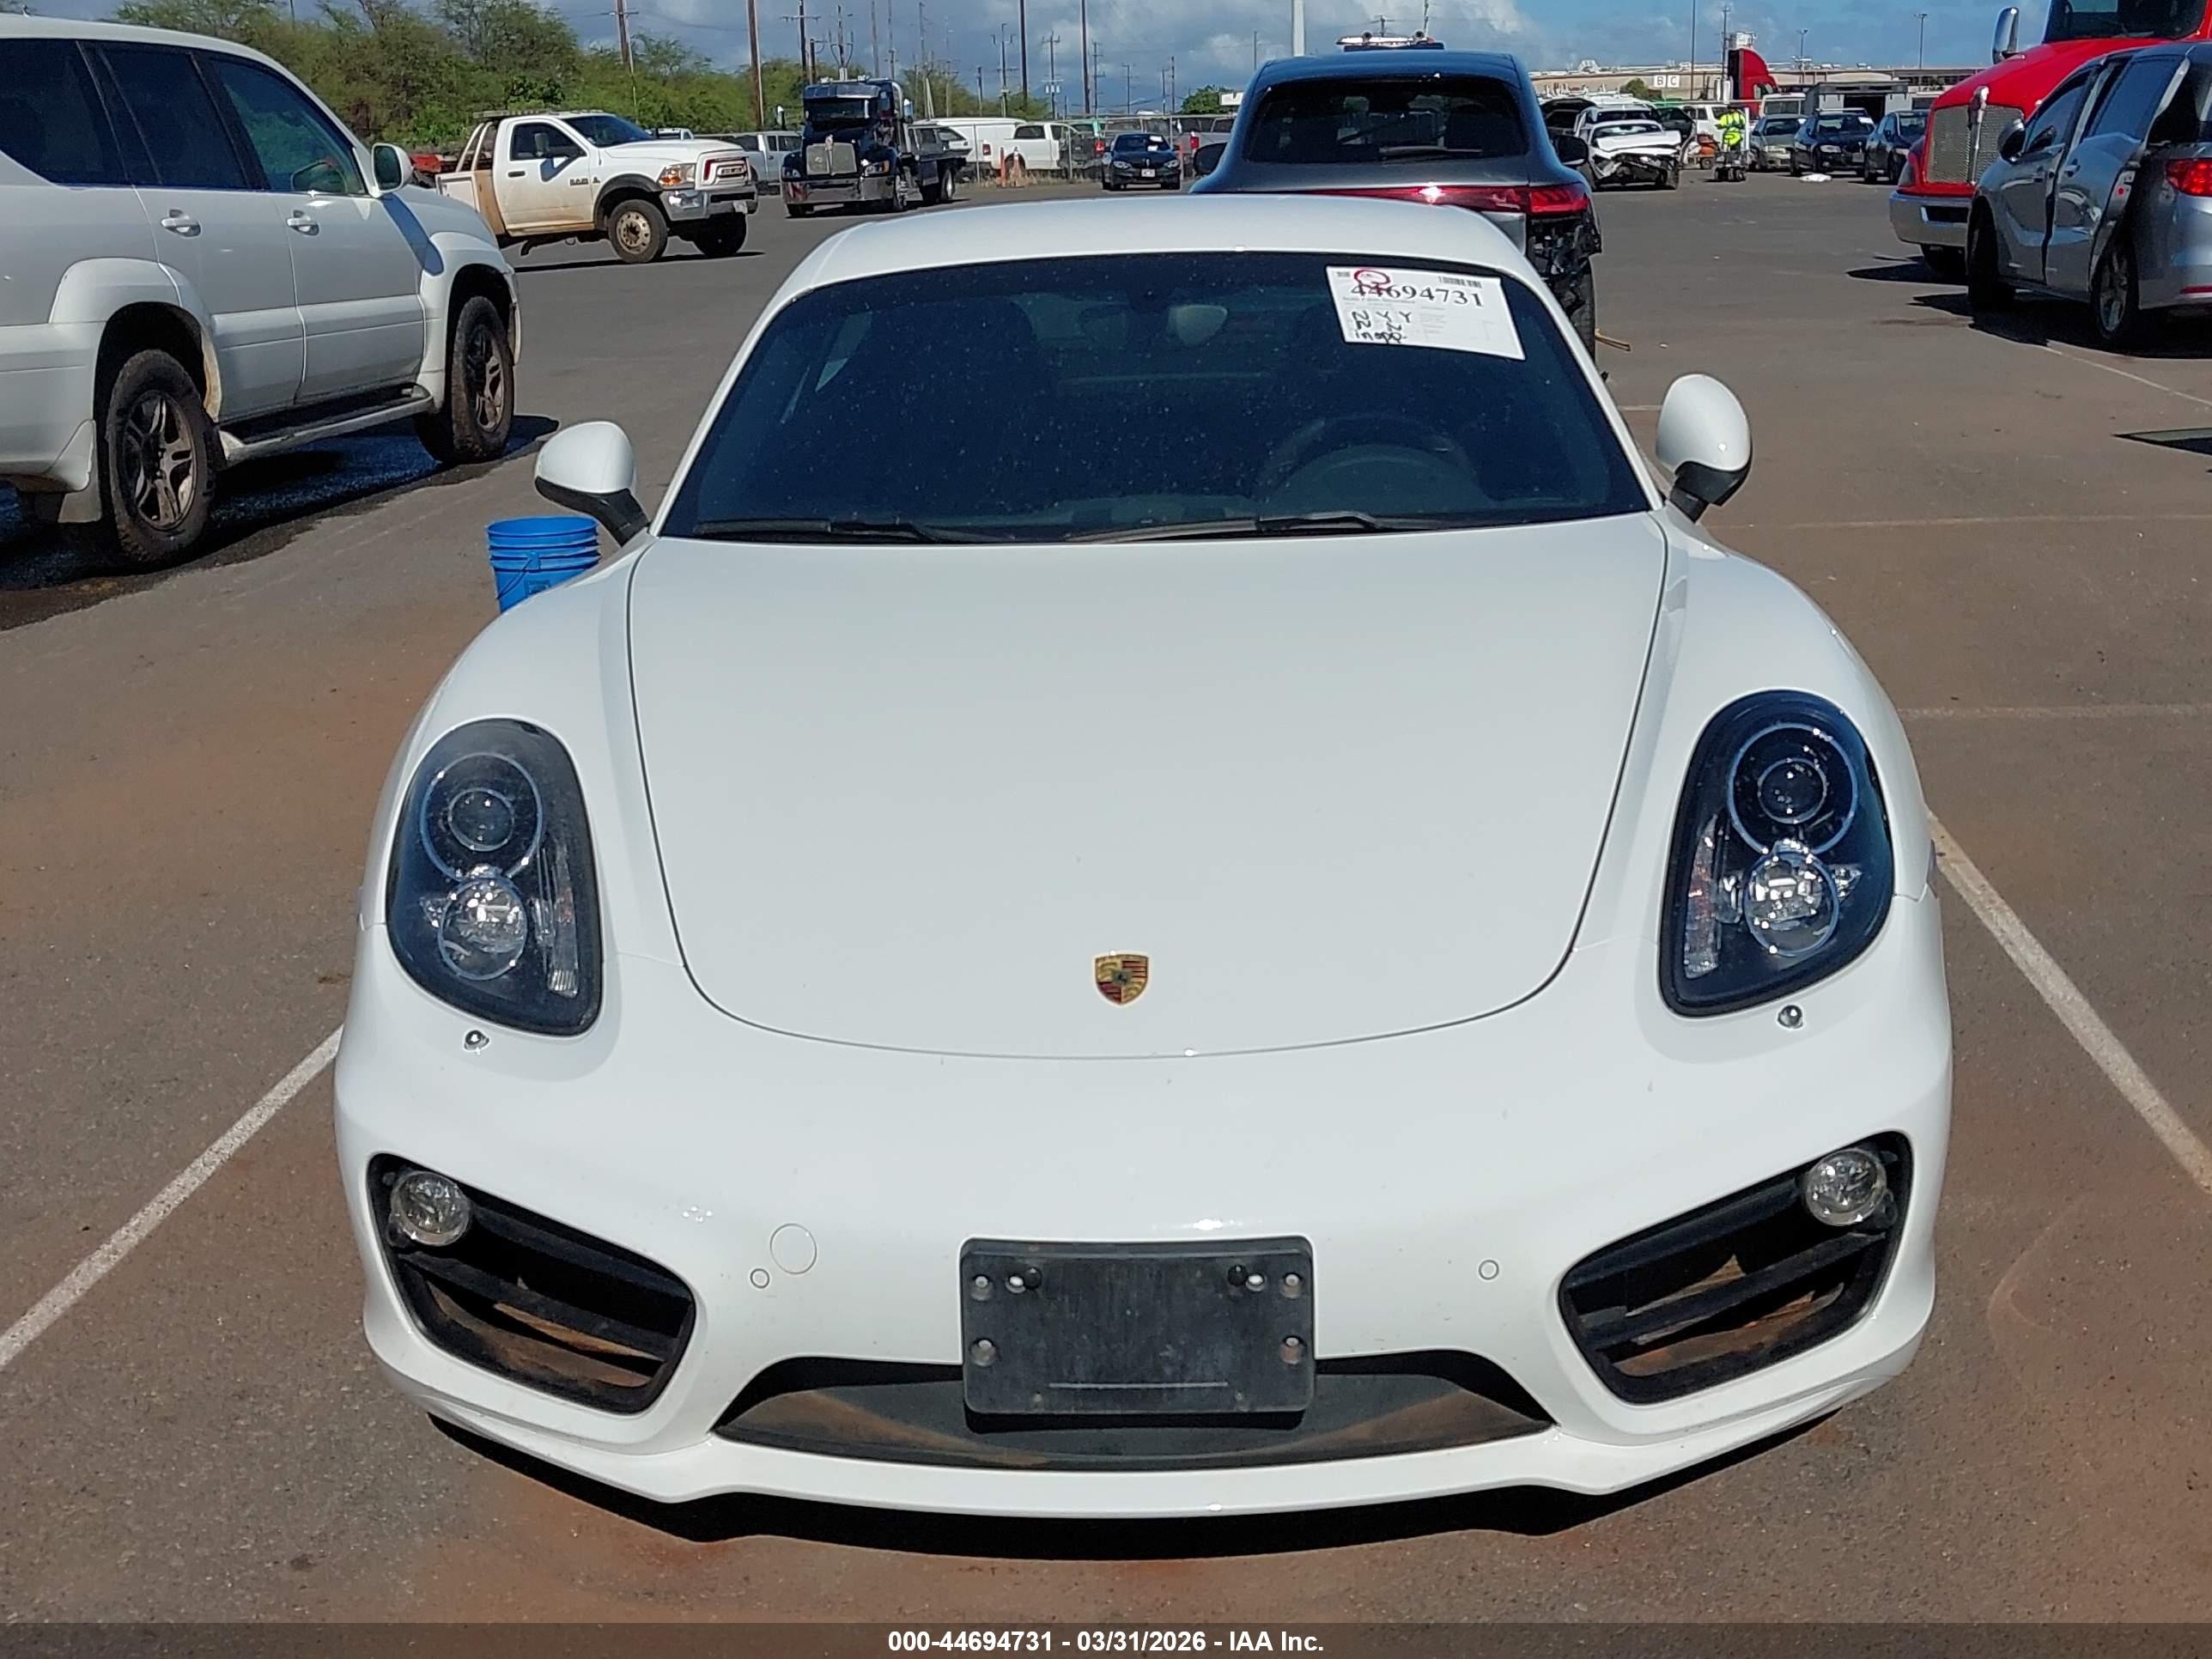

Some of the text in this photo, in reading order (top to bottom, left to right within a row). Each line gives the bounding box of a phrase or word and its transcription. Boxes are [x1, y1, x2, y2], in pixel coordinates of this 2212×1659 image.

[1656, 76, 1664, 86] B
[1670, 76, 1677, 86] C
[1351, 282, 1485, 308] 44694731
